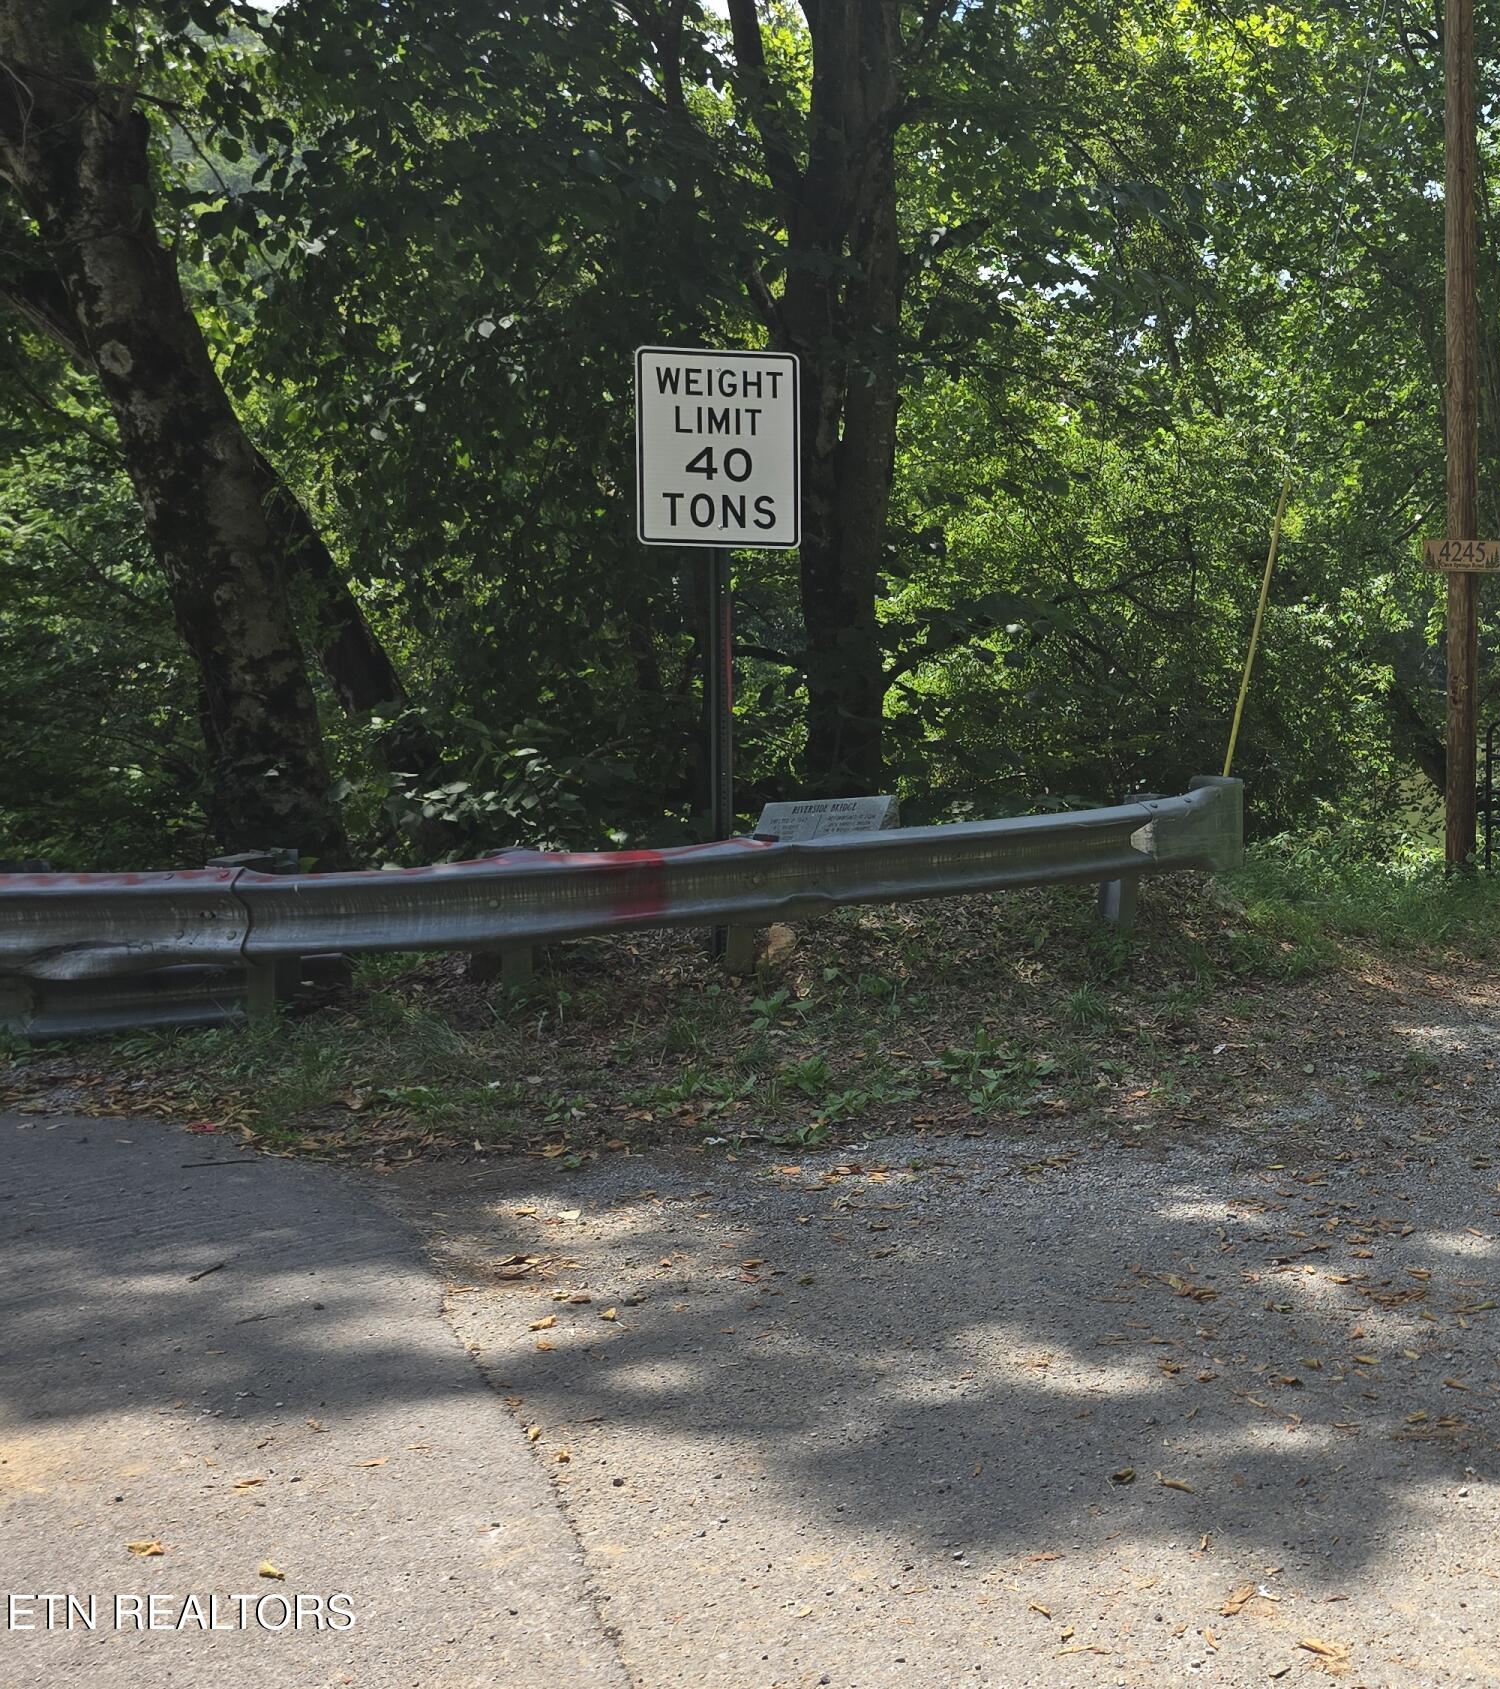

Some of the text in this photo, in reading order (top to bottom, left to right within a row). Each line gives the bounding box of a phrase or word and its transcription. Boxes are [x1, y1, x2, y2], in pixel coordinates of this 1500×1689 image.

[655, 366, 784, 399] WEIGHT
[674, 405, 762, 436] LIMIT
[685, 446, 753, 483] 40
[662, 492, 777, 530] TONS
[1440, 541, 1486, 562] 4245
[791, 802, 858, 815] RIVERSIDE BRIDGE
